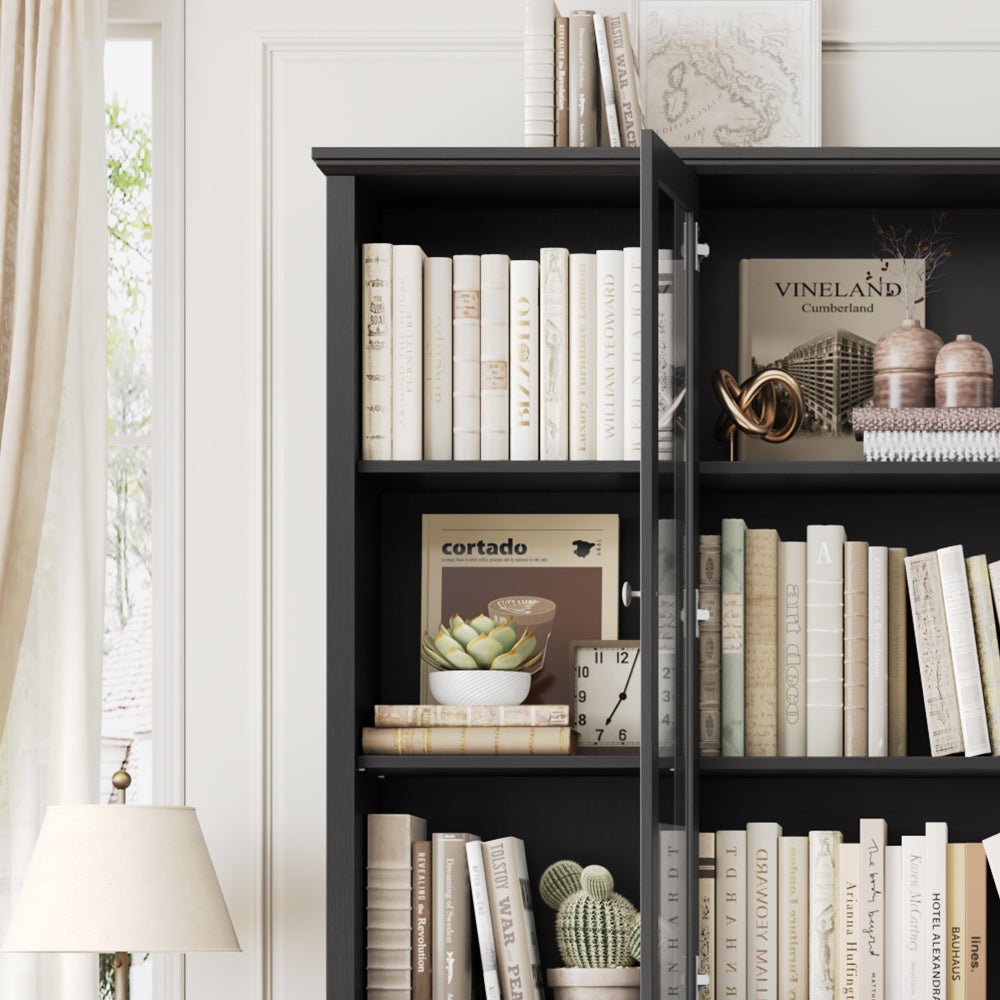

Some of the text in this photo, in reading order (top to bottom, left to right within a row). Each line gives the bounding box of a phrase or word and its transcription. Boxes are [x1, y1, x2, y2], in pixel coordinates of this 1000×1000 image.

[610, 15, 638, 148] TOLSTOY WAR PEACE
[775, 282, 902, 298] VINELAND
[801, 303, 874, 313] Cumberland
[578, 264, 588, 452] Luxury Furniture London
[604, 273, 616, 440] WILLIAM YEOWARD
[441, 538, 528, 556] cortado
[816, 541, 832, 564] A
[577, 666, 589, 678] 10
[595, 652, 629, 664] 11 12
[786, 584, 801, 725] art deco
[578, 690, 587, 703] 9
[578, 714, 587, 726] 8
[595, 729, 628, 741] 7 6
[491, 843, 509, 890] TOLSTOY
[868, 838, 880, 867] The
[910, 853, 921, 888] Karen
[417, 852, 426, 900] REVEALING
[445, 858, 454, 943] Dreaming of Sweden
[846, 881, 857, 936] Arianna
[932, 892, 941, 931] HOTEL
[498, 896, 516, 947] WAR
[907, 891, 922, 952] McCartney
[418, 917, 427, 973] Revolution
[951, 926, 961, 981] BAUHAUS
[971, 936, 982, 973] lines.
